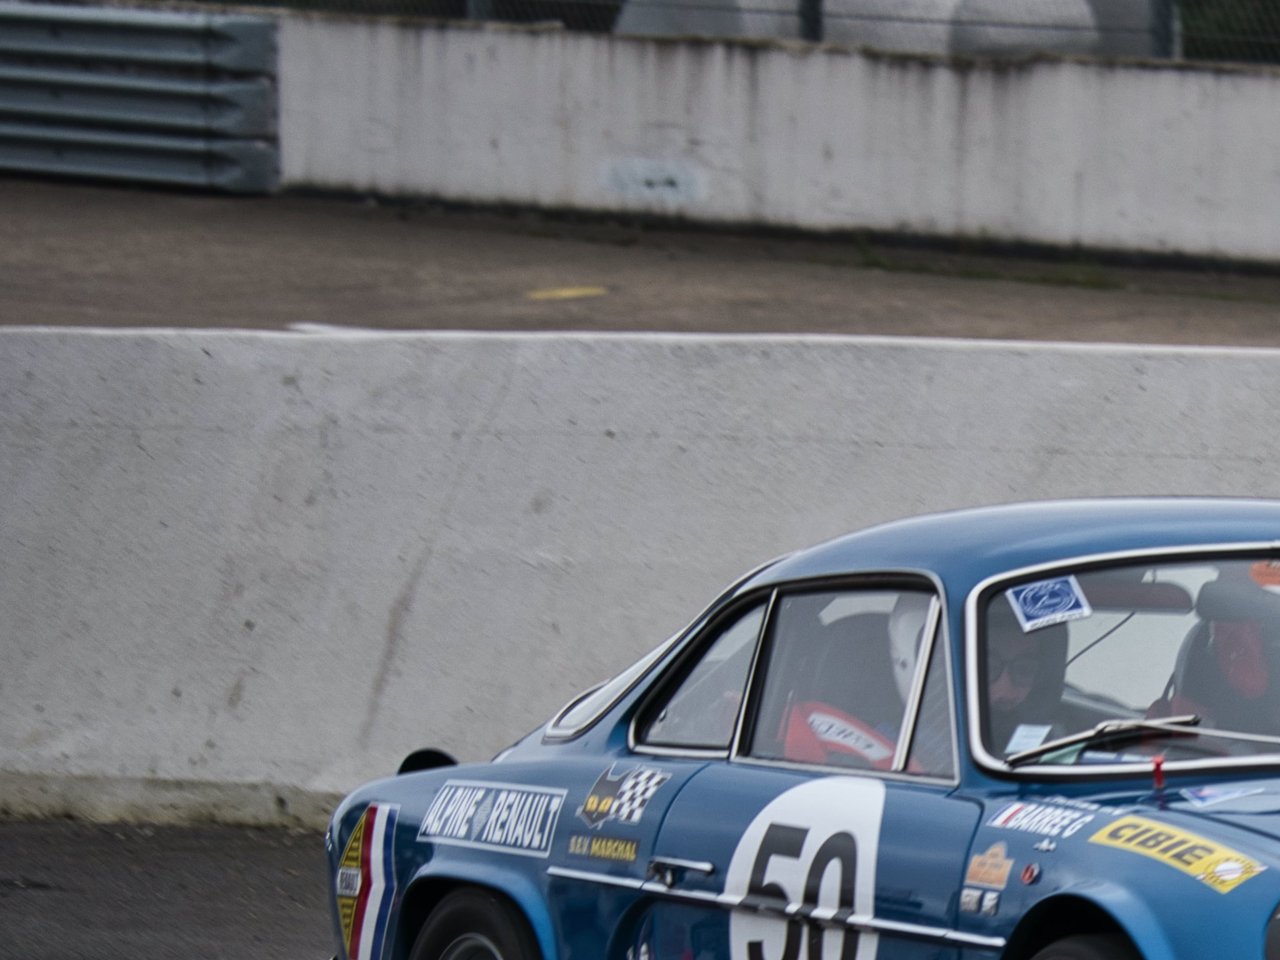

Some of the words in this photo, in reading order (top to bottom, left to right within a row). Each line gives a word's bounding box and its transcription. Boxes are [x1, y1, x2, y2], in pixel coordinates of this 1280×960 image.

[423, 786, 486, 837] ALPINE
[482, 791, 561, 849] RENAULT
[591, 837, 637, 861] MARCHAL
[1108, 824, 1214, 867] CIBIE
